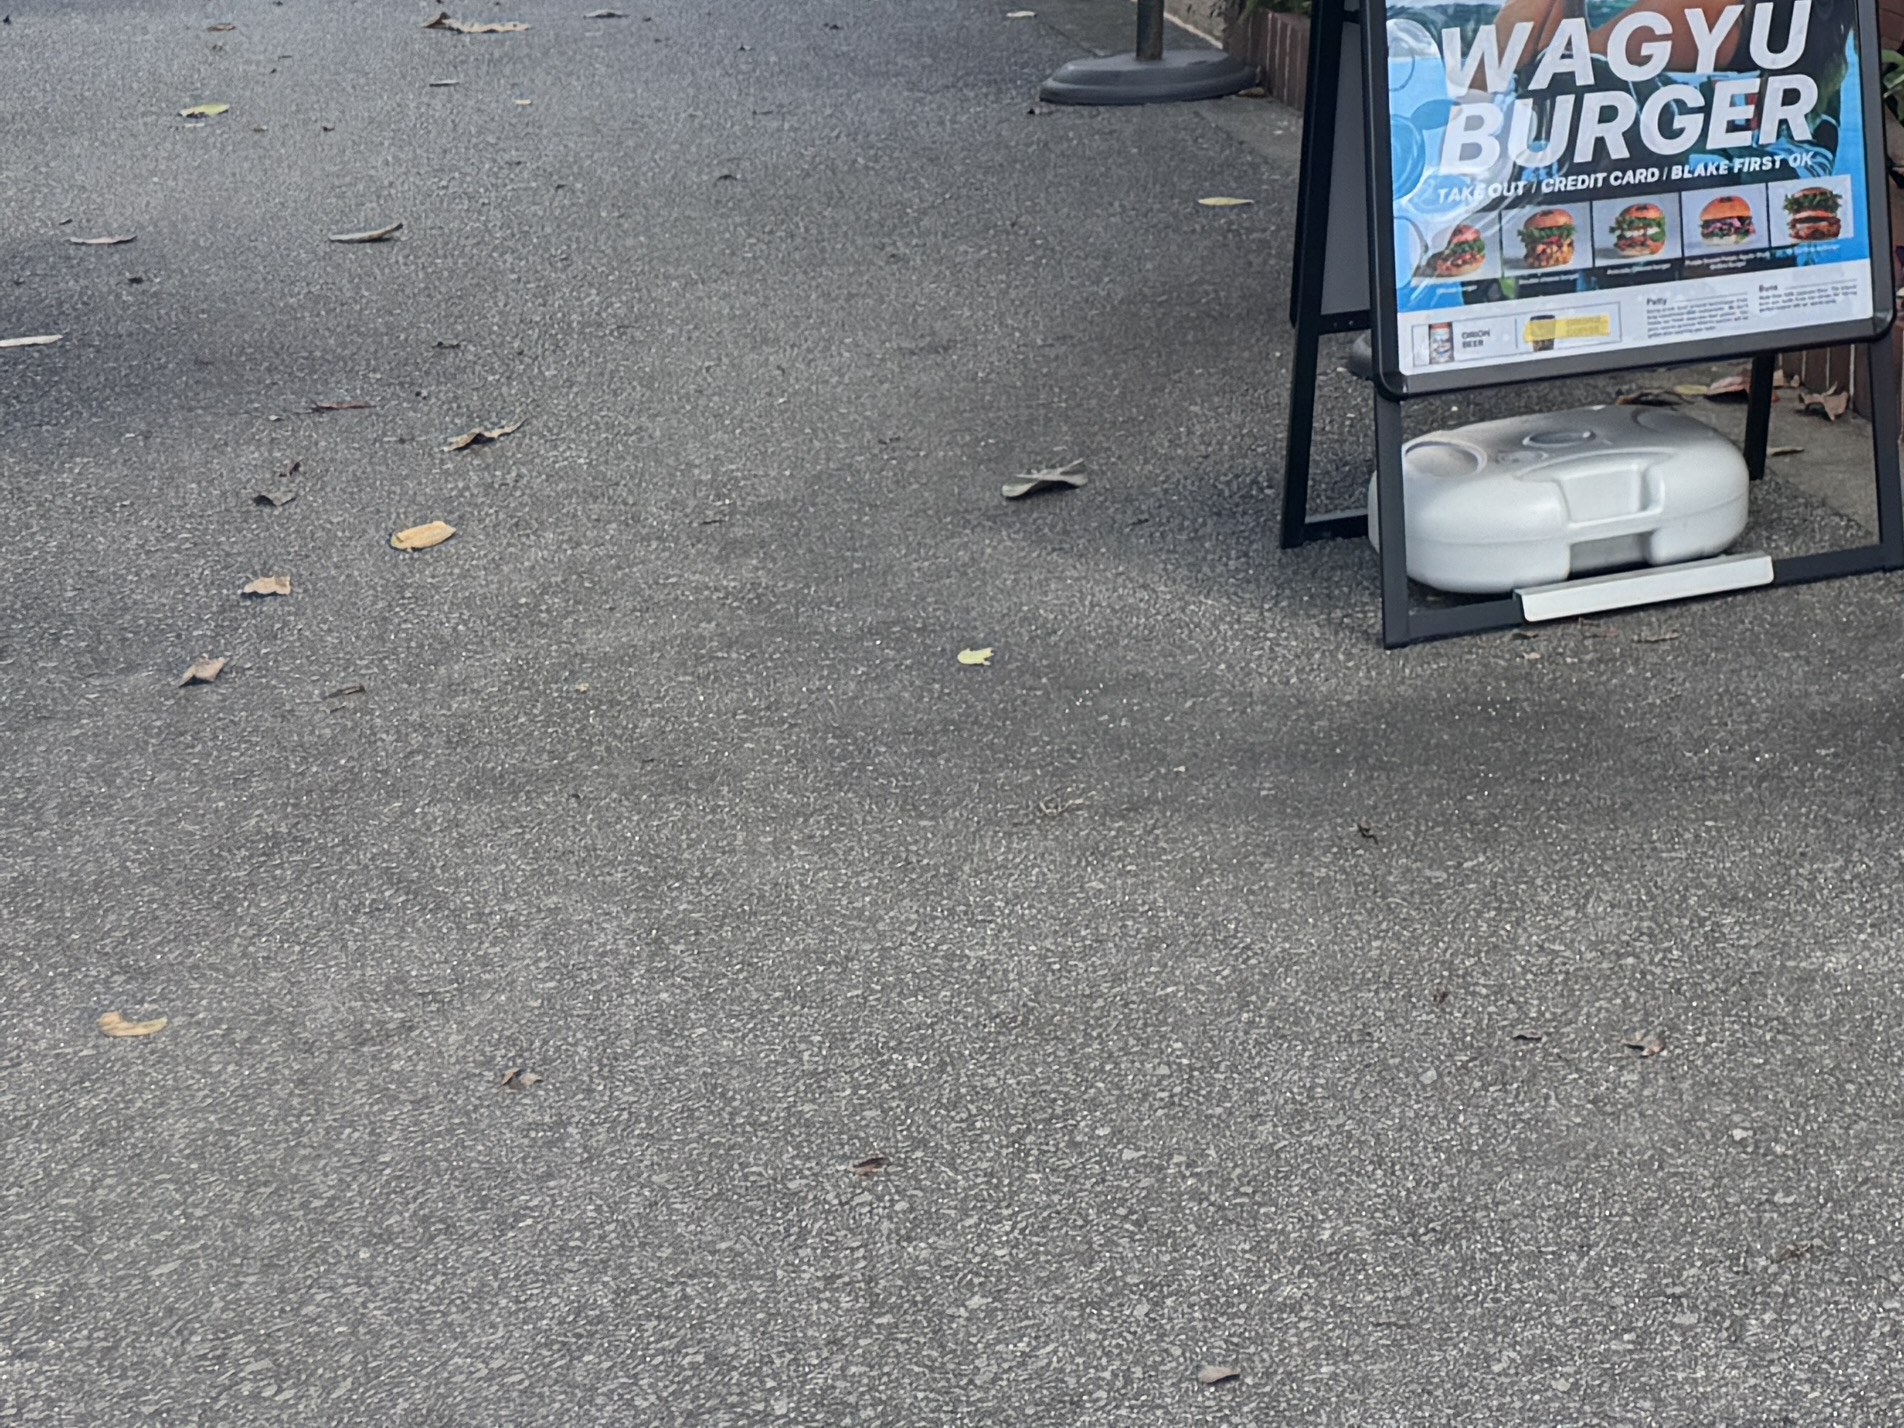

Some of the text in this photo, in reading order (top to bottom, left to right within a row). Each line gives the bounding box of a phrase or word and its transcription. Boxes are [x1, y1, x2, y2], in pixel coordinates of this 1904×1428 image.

[1441, 0, 1812, 97] WAGYU
[1439, 74, 1819, 176] BURGER
[1438, 186, 1484, 204] TAKE
[1487, 180, 1526, 197] OUT
[1540, 172, 1608, 194] CREDIT
[1609, 167, 1660, 187] CARD
[1671, 160, 1730, 181] BLAKE
[1732, 156, 1784, 174] FIRST
[1788, 150, 1814, 168] OK
[1646, 296, 1667, 307] Patty
[1462, 339, 1484, 349] BEER
